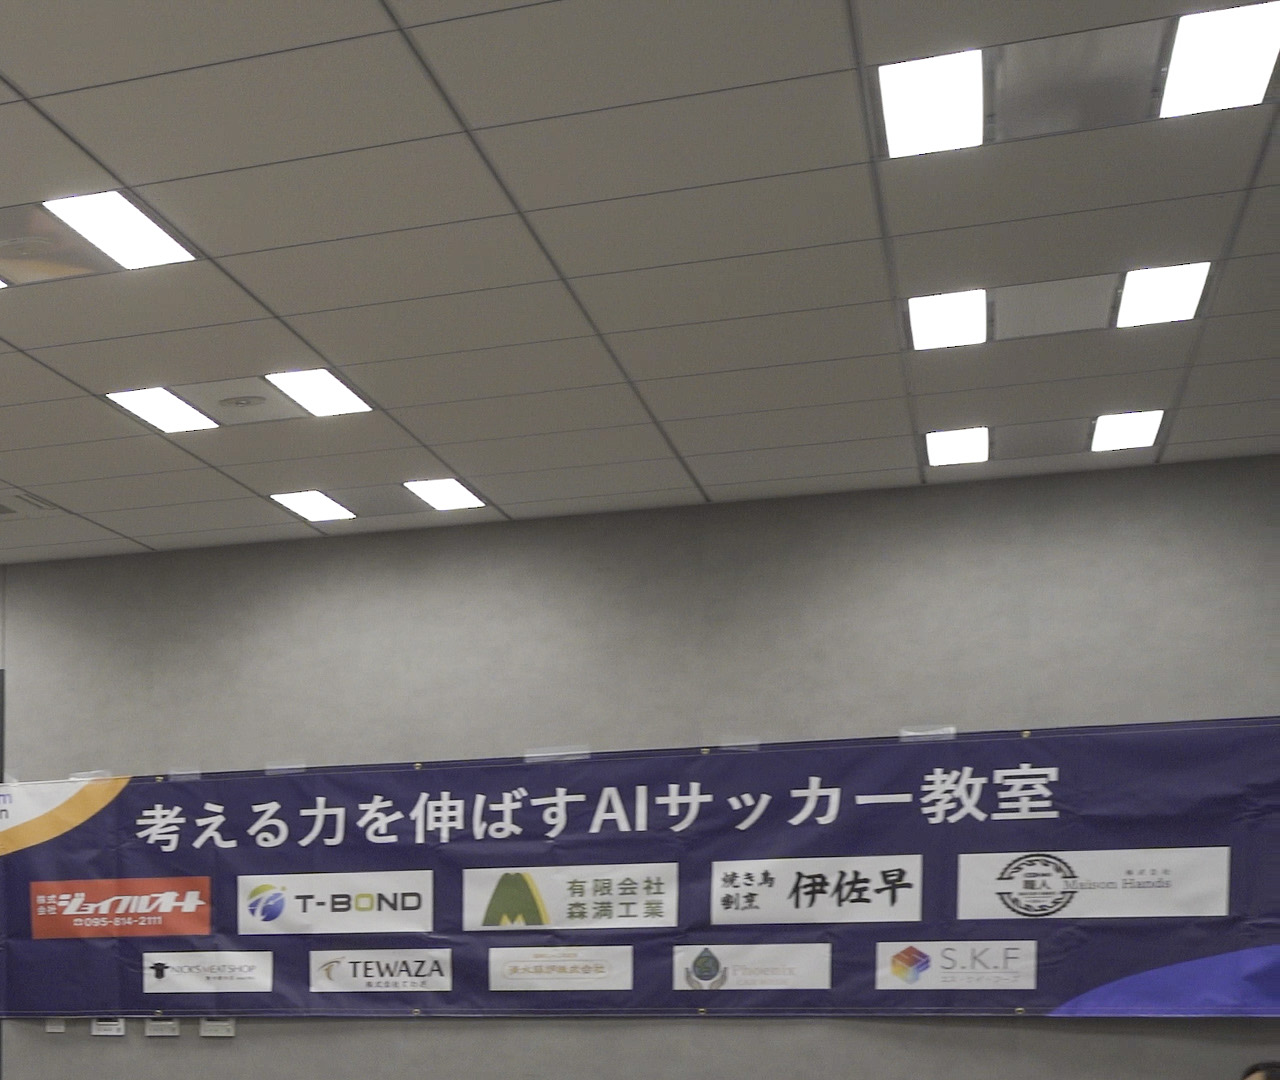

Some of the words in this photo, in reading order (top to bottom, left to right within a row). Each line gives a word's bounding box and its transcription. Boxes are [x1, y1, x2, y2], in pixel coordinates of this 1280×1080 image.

[135, 763, 1060, 852] 考える力を伸ばすAIサッカー教室
[566, 876, 666, 898] 有限会社
[295, 891, 422, 913] T-BOND
[348, 959, 445, 979] TEWAZA
[940, 947, 1020, 970] S.K.F
